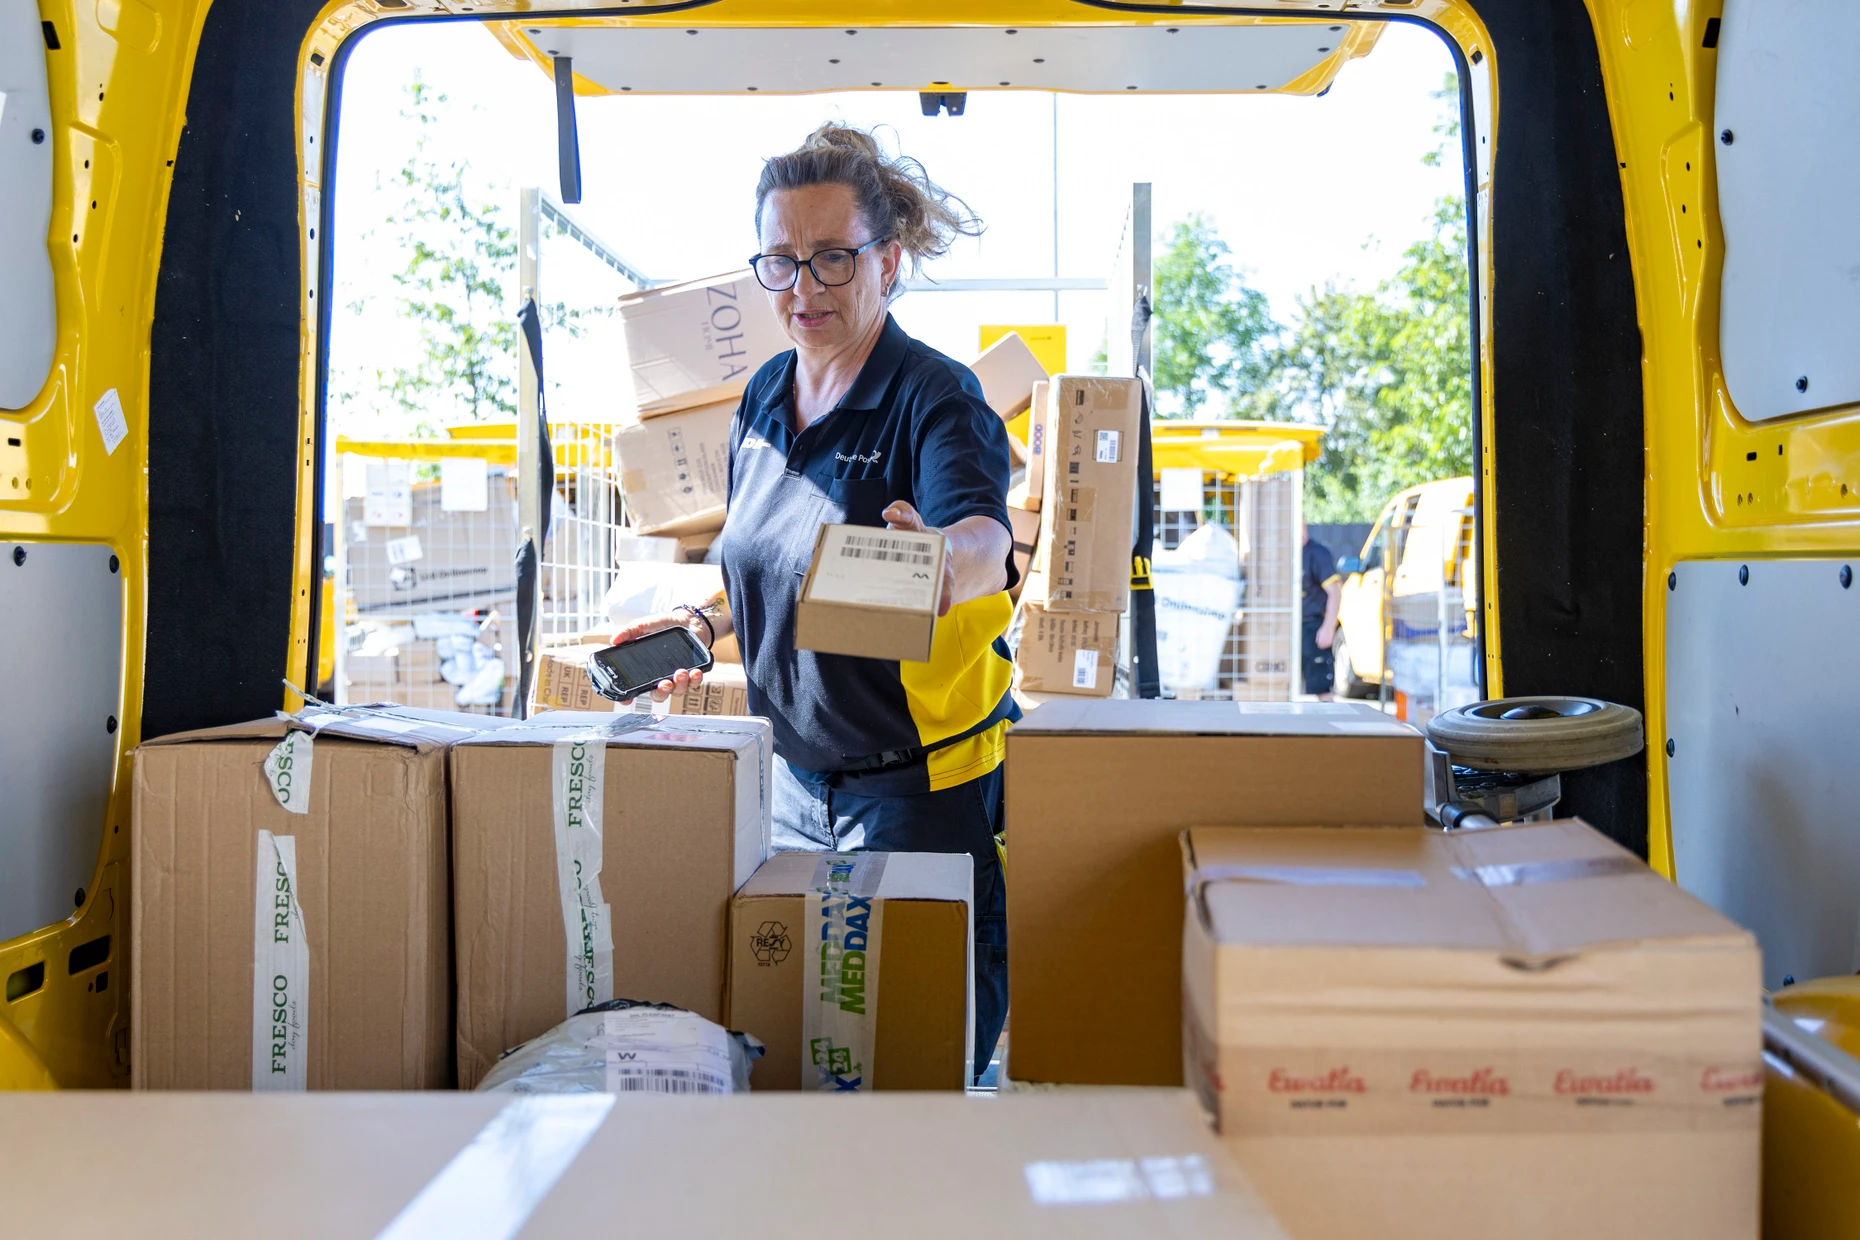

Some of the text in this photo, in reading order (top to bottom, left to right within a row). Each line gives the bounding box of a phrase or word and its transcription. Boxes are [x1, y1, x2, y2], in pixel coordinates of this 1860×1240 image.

[706, 282, 748, 381] ZOHA
[561, 686, 570, 703] REP
[580, 689, 589, 706] REP
[274, 855, 290, 944] FRESC
[840, 894, 874, 1015] MEDDAX
[271, 974, 288, 1074] FRESCO
